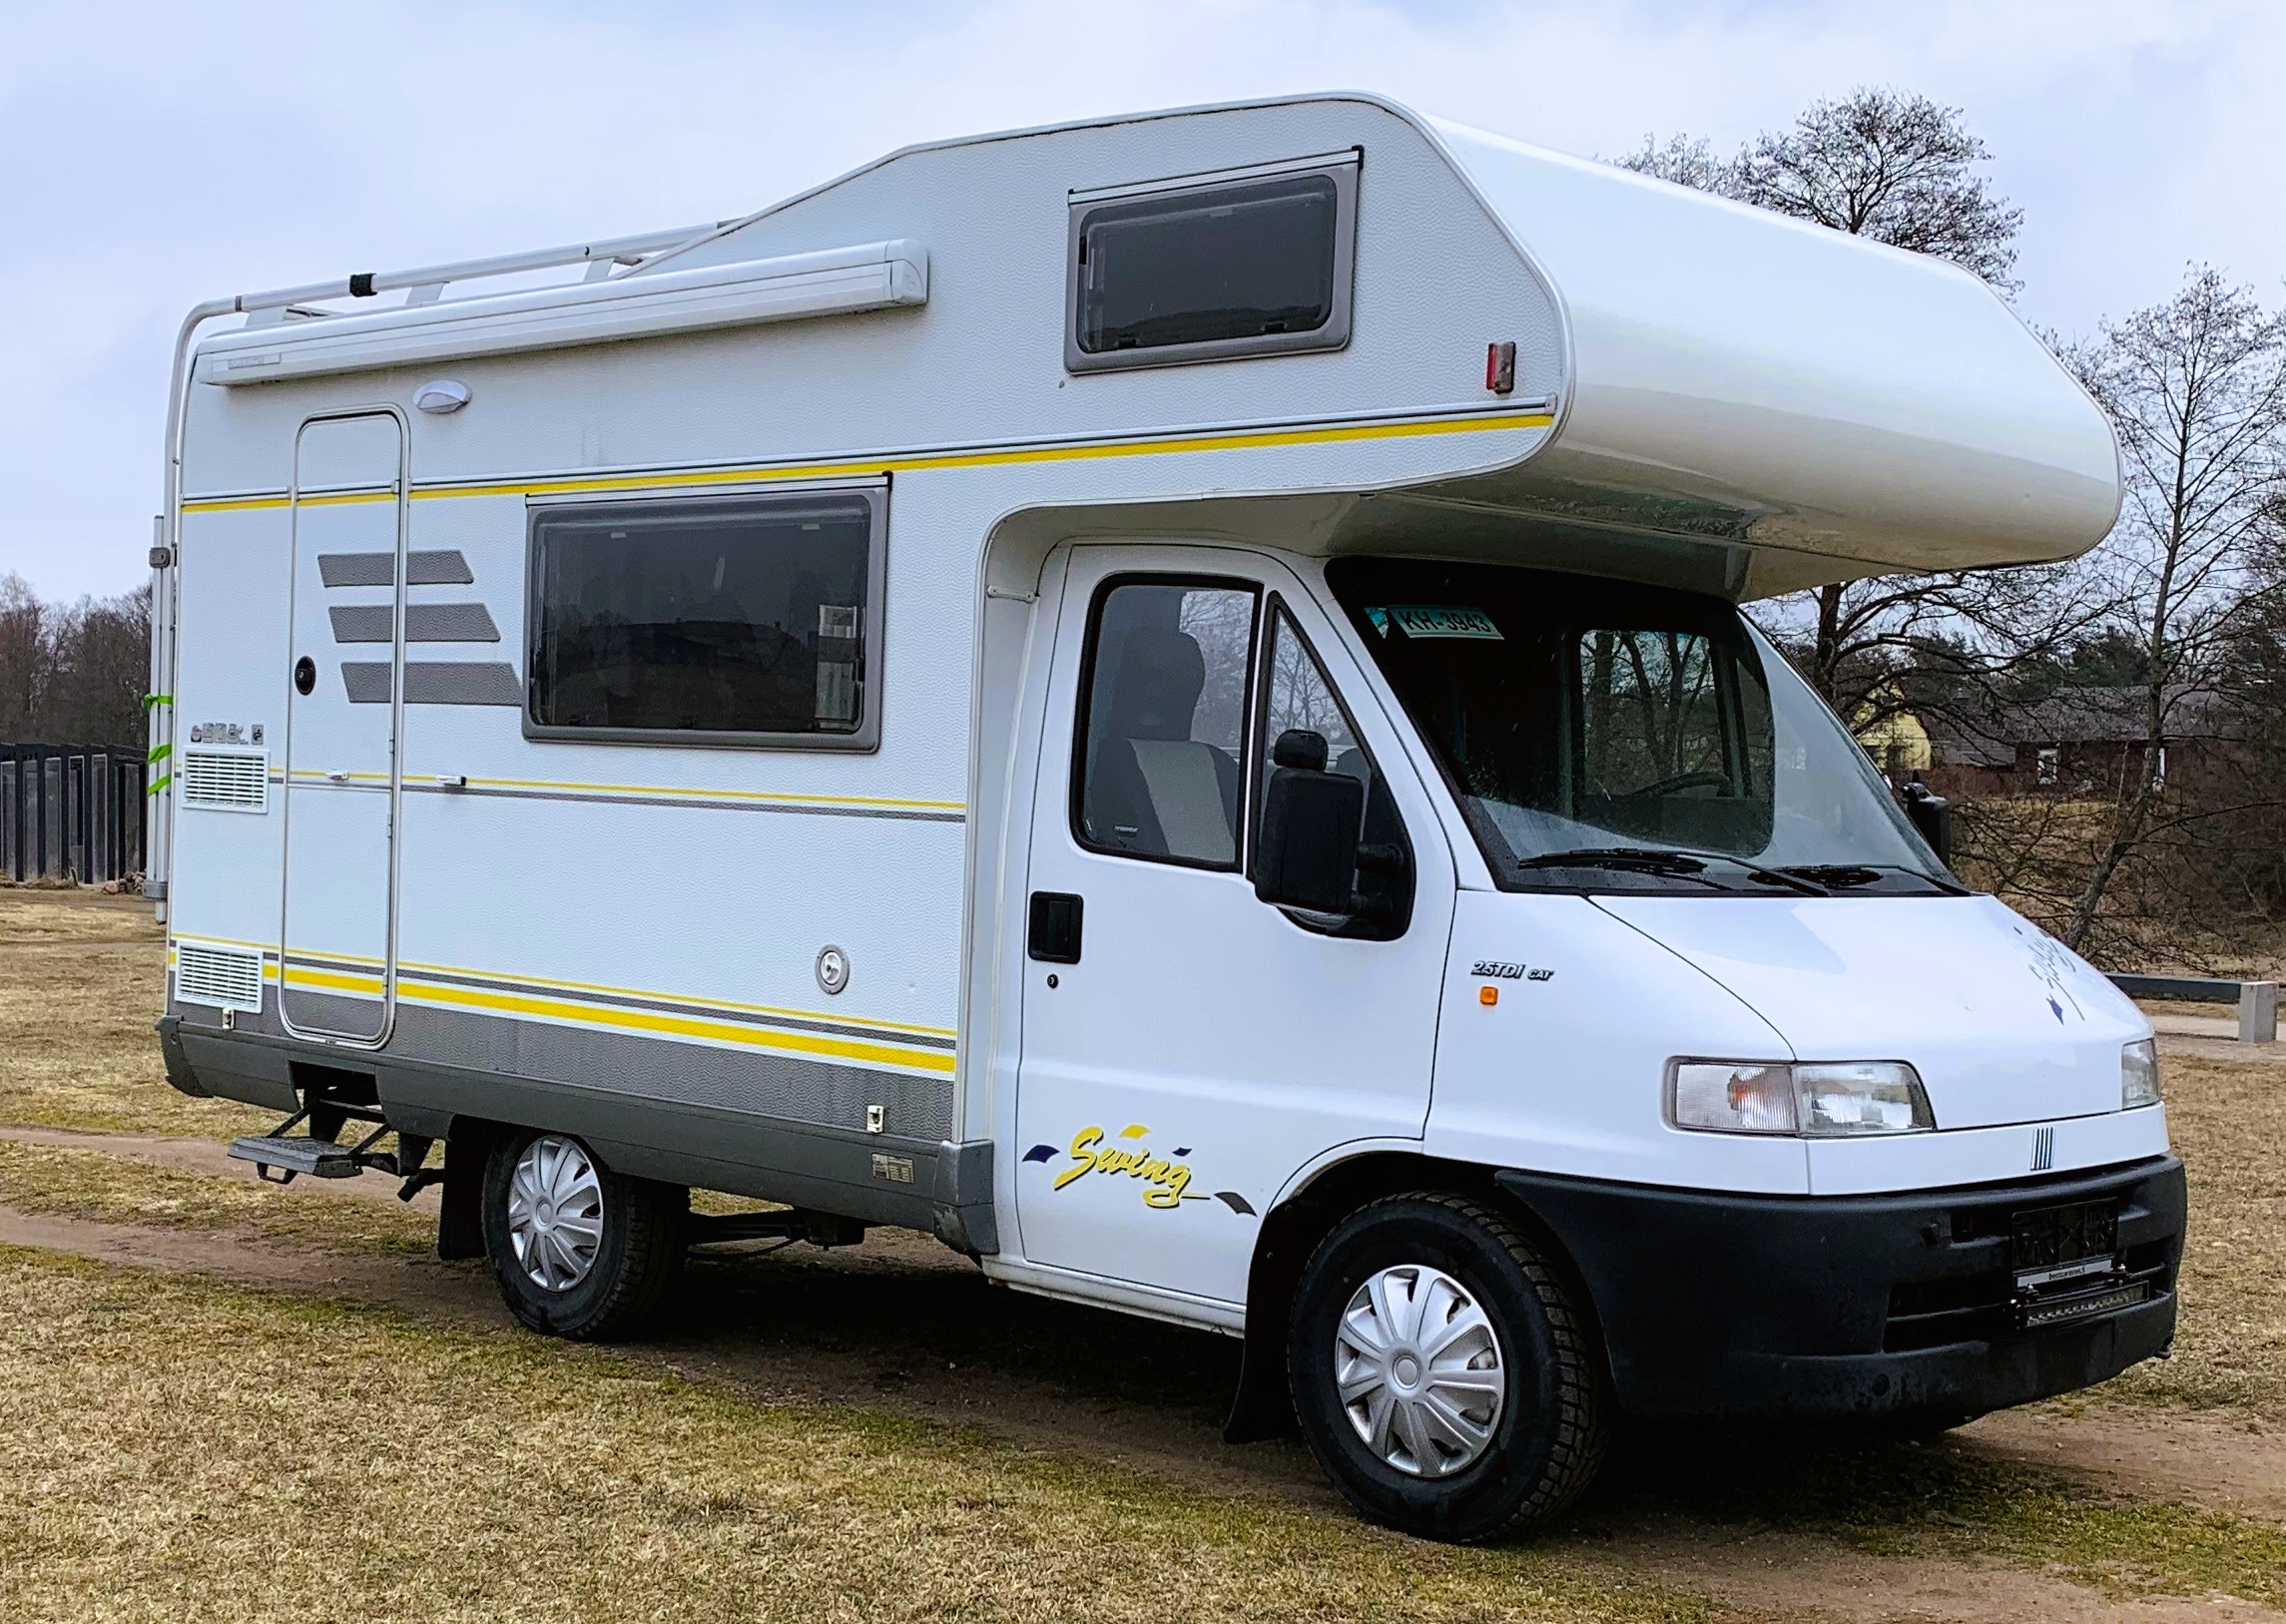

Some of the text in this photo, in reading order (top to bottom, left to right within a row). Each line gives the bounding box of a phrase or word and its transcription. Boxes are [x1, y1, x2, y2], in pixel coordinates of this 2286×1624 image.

[1398, 610, 1492, 632] KH-3943
[1527, 969, 1554, 981] CAT
[1053, 1126, 1210, 1209] Swing
